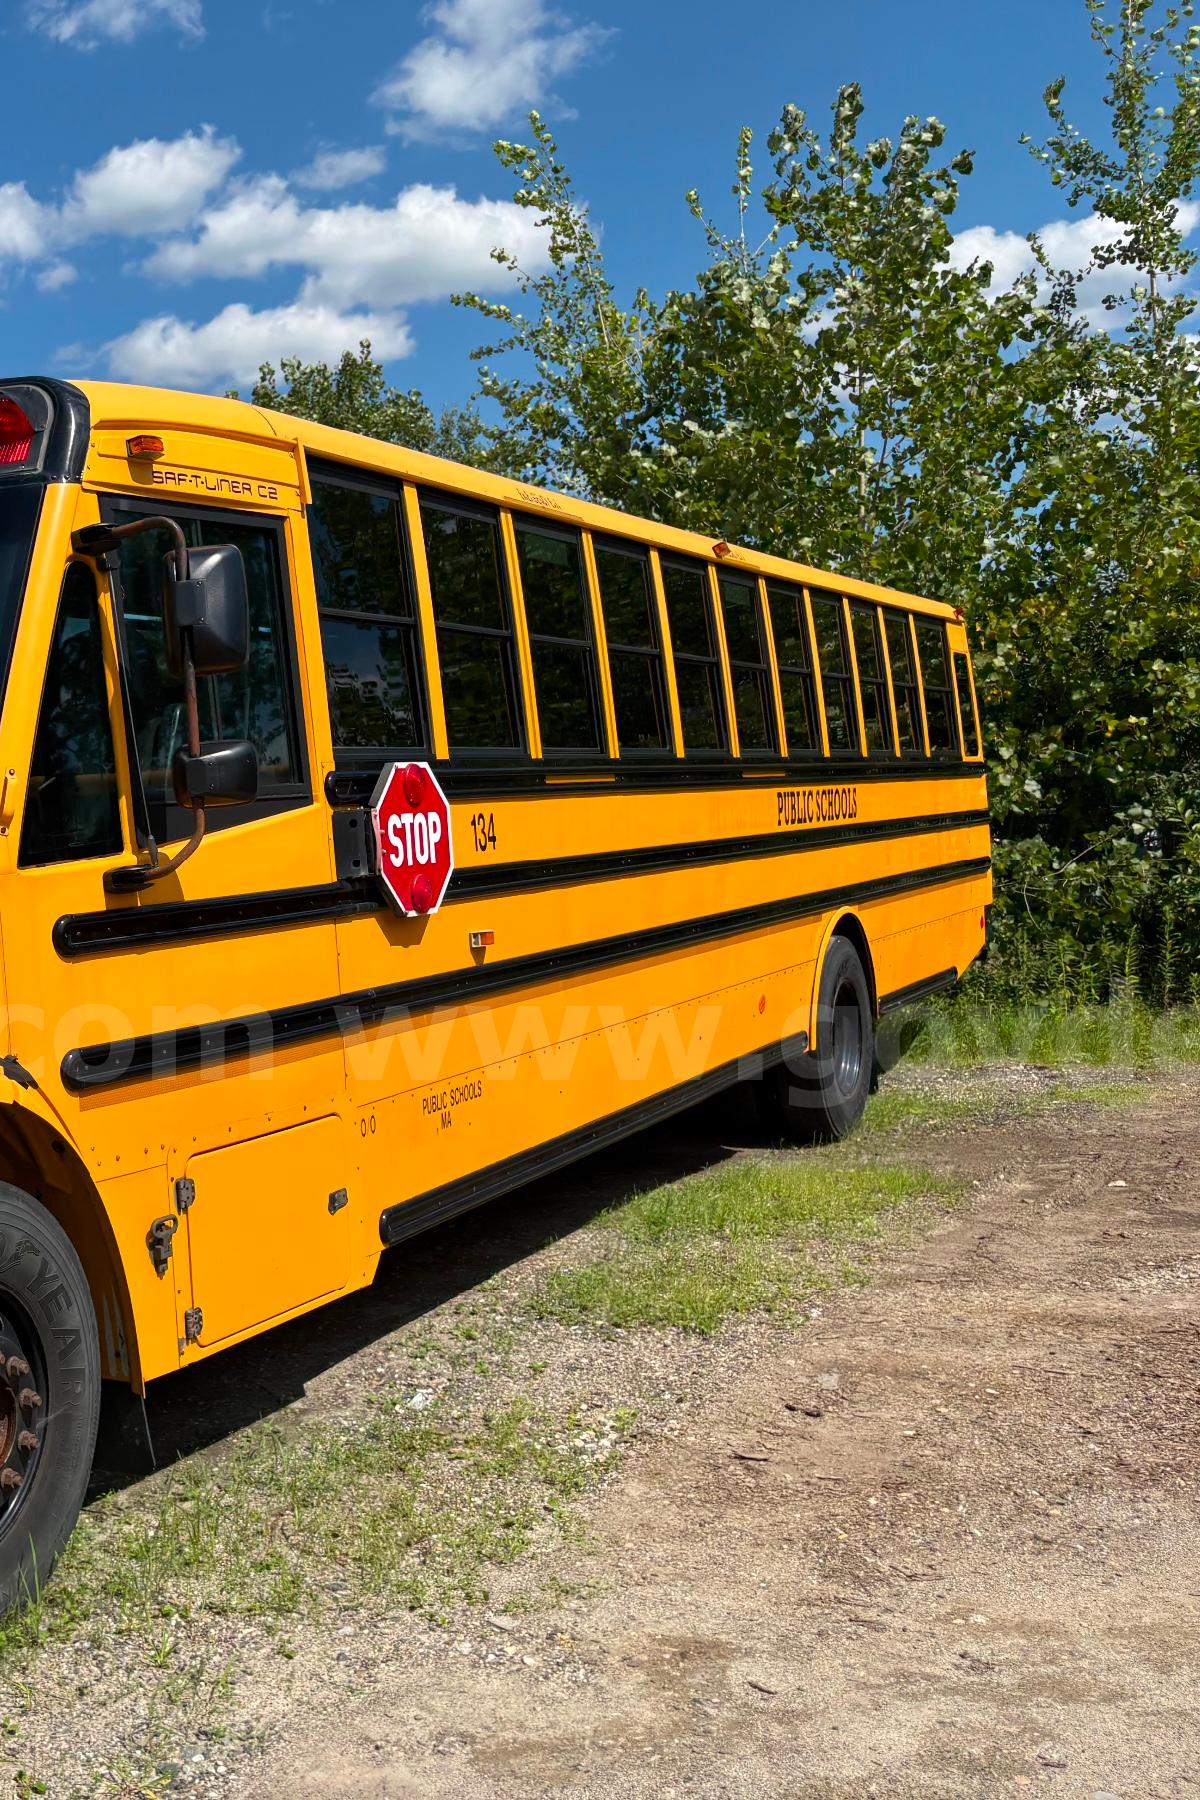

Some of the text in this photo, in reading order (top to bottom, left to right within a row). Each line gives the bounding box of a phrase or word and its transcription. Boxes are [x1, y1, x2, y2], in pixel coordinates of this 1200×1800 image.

[152, 470, 279, 500] SAF-T-LINER C2
[777, 787, 858, 827] PUBLIC SCHOOLS
[387, 811, 442, 868] STOP
[470, 812, 497, 852] 134
[422, 1080, 483, 1116] PUBLIC SCHOOLS
[441, 1111, 452, 1130] MA
